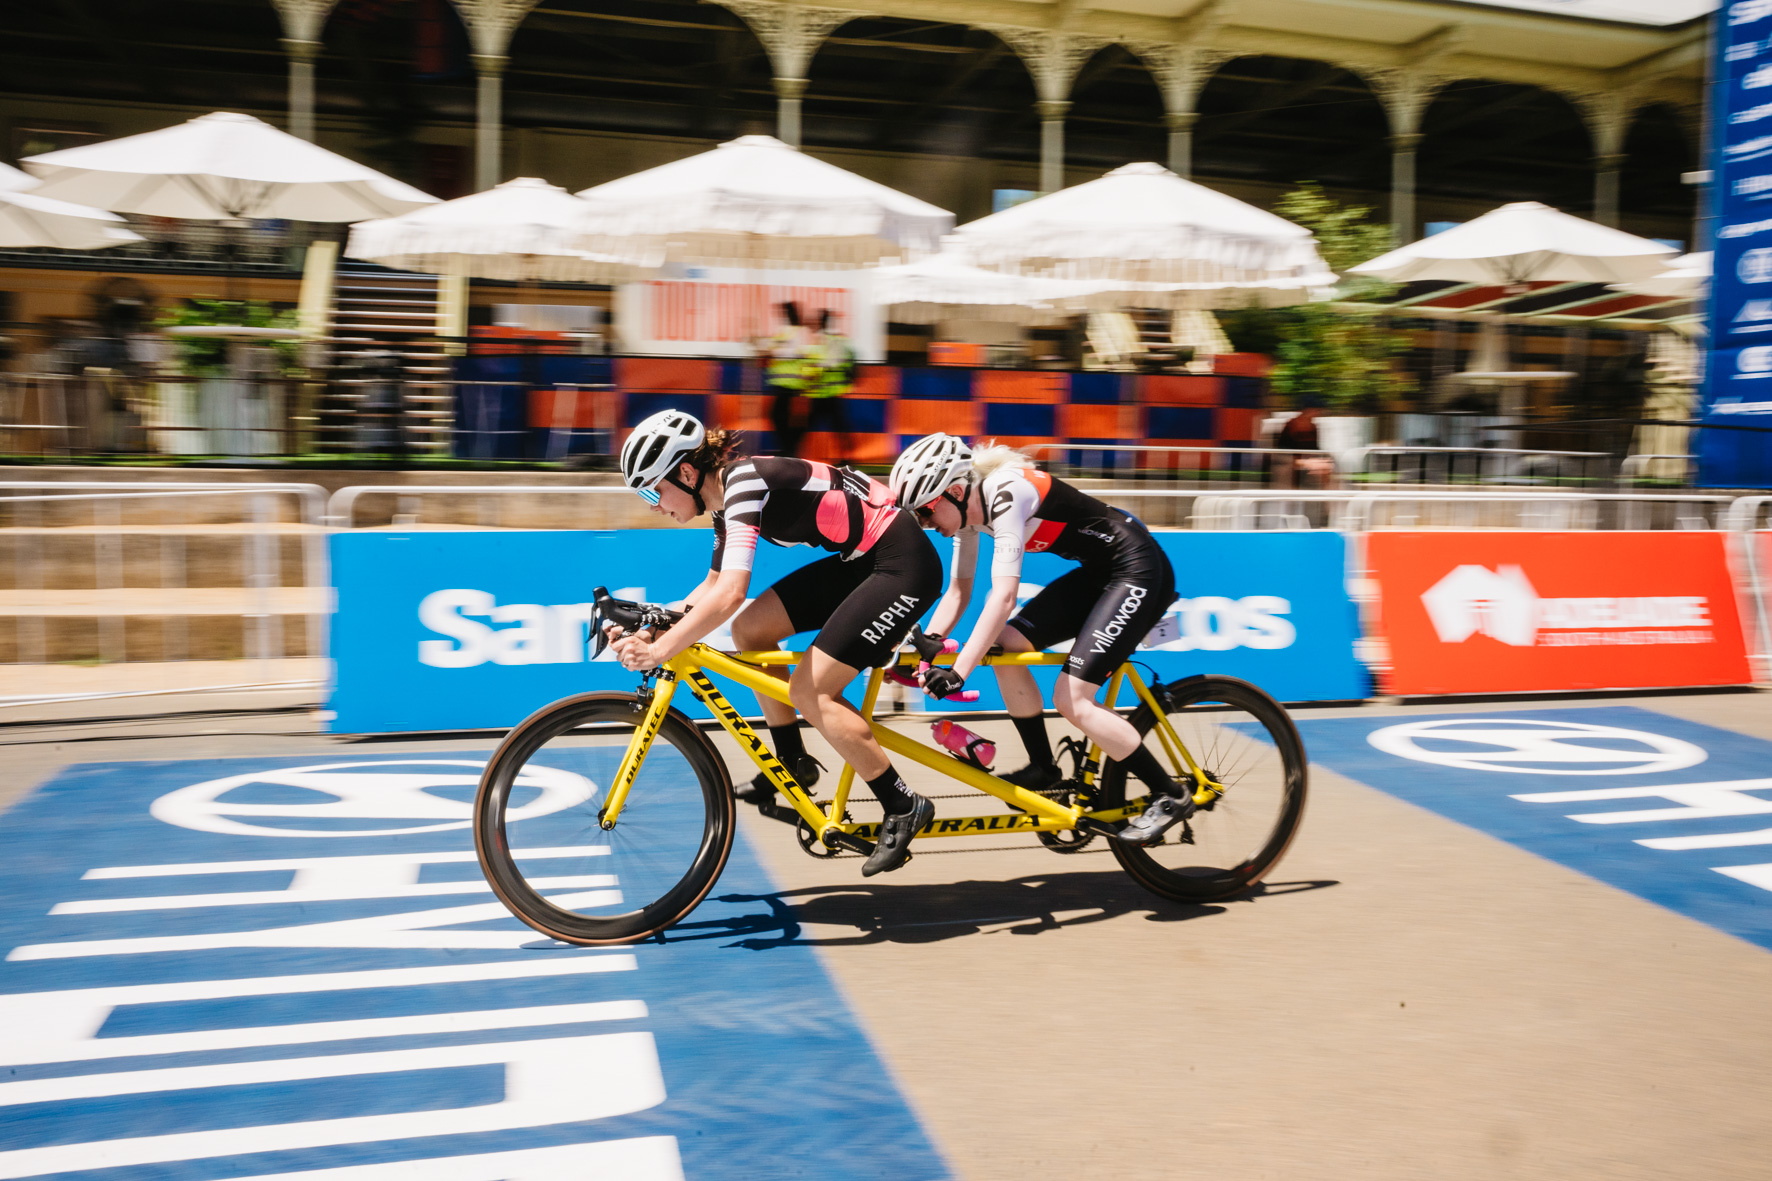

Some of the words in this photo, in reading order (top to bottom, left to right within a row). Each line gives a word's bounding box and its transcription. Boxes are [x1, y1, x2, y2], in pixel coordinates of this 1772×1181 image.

[860, 594, 920, 645] RAPHA
[1090, 584, 1148, 654] villawood
[625, 706, 664, 785] DURATEC
[689, 670, 806, 802] DURATEC
[850, 814, 1040, 838] ATRALIA
